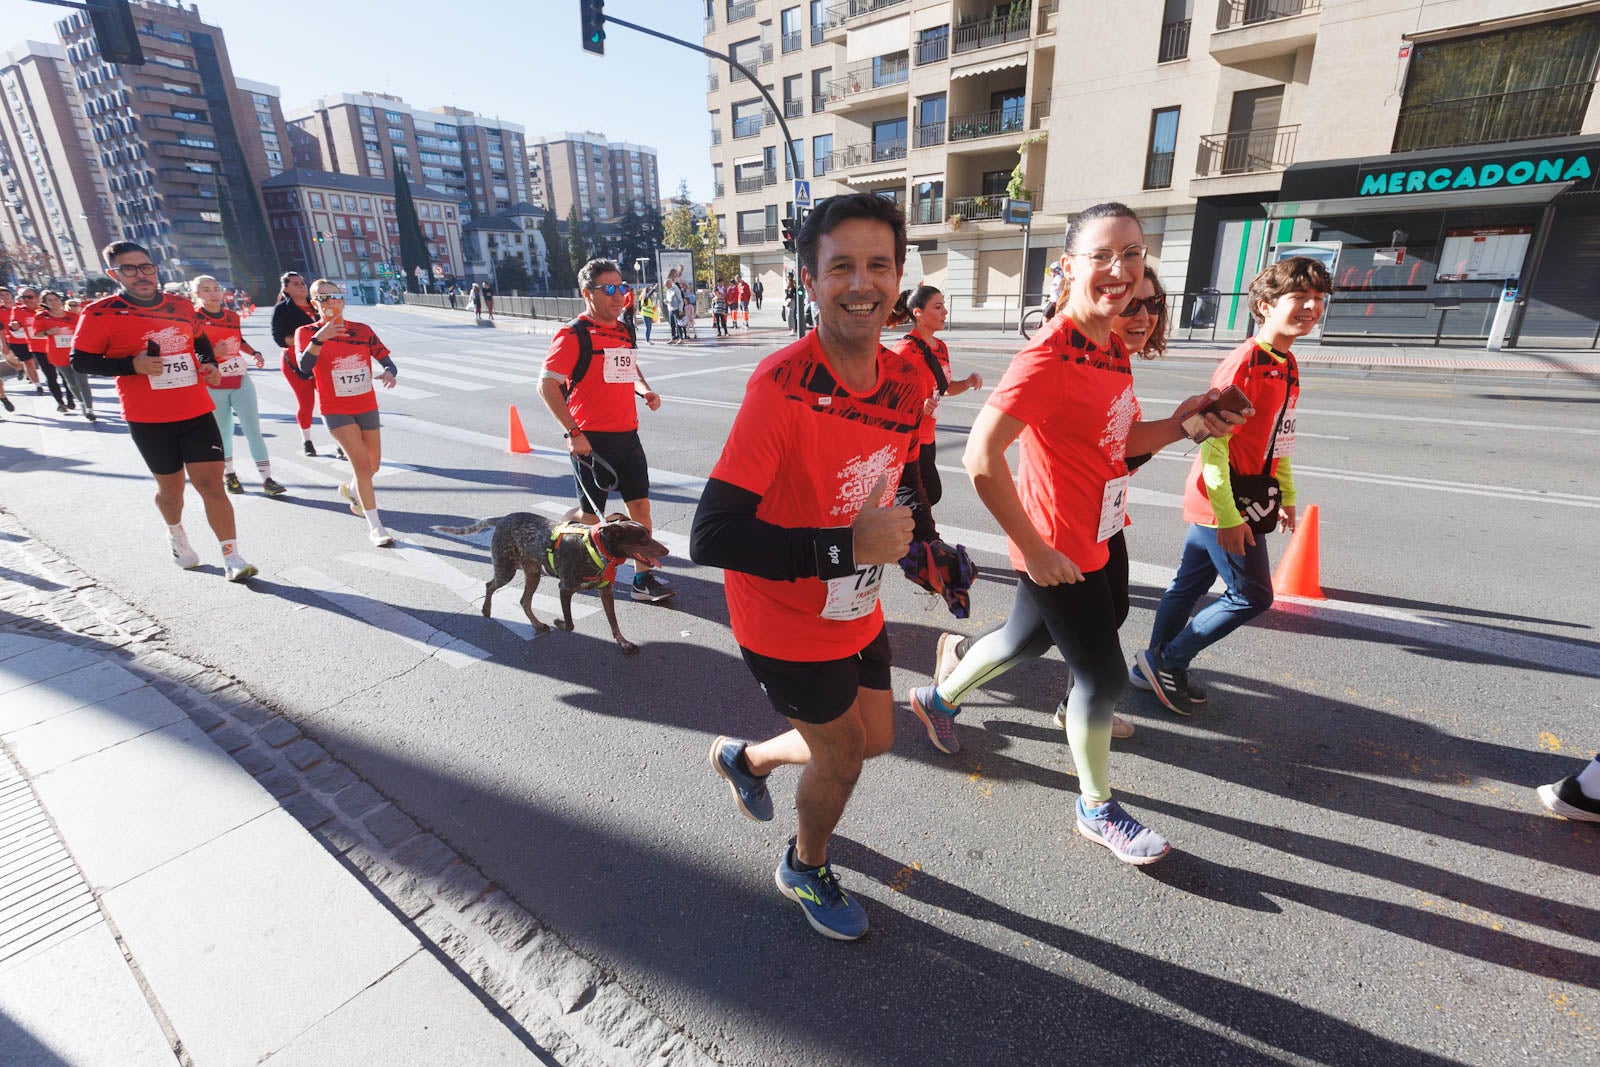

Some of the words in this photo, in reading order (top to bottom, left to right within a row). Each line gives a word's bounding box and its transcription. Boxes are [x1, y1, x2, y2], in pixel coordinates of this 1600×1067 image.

[1360, 155, 1591, 196] MERCADONA
[221, 362, 240, 373] 214
[613, 355, 631, 367] 159
[339, 373, 366, 384] 1757
[841, 470, 900, 498] carrra
[828, 544, 841, 565] edp
